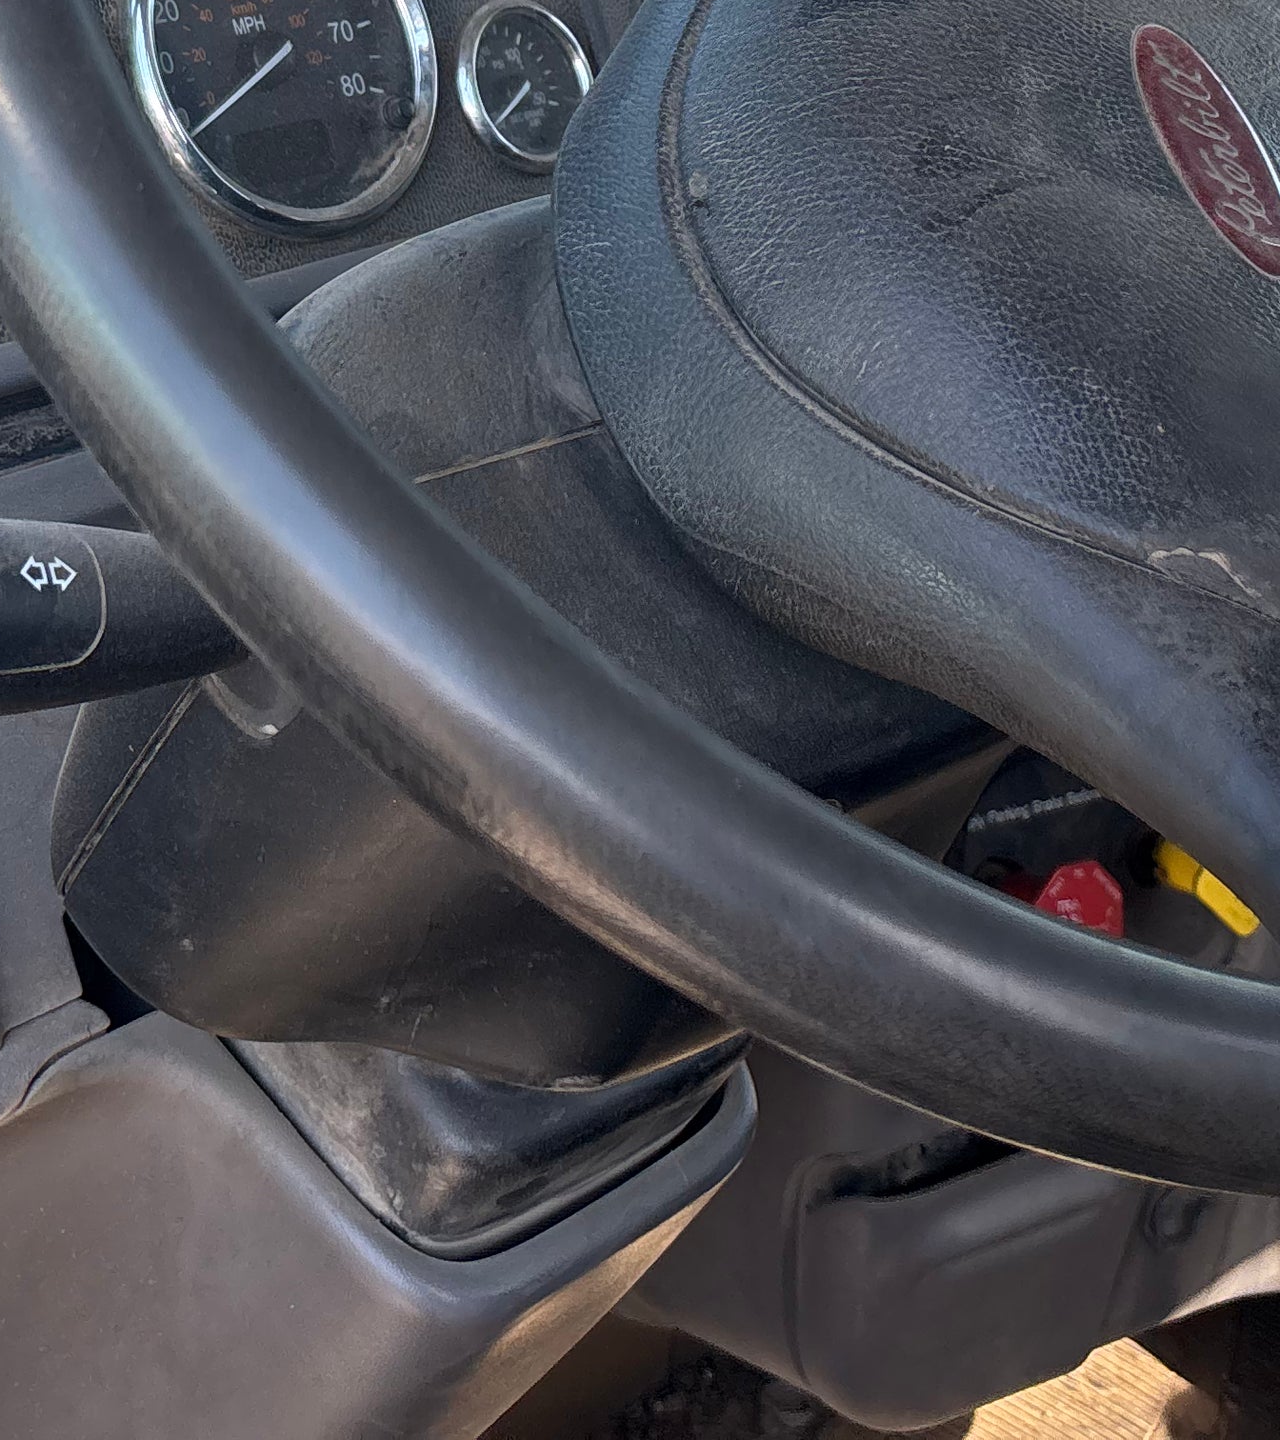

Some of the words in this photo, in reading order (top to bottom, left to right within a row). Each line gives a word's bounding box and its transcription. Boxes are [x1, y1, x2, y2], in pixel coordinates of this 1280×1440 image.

[199, 8, 214, 23] 40
[232, 15, 267, 37] MPH
[328, 19, 354, 45] 70
[191, 48, 207, 63] 20
[340, 72, 367, 98] 80
